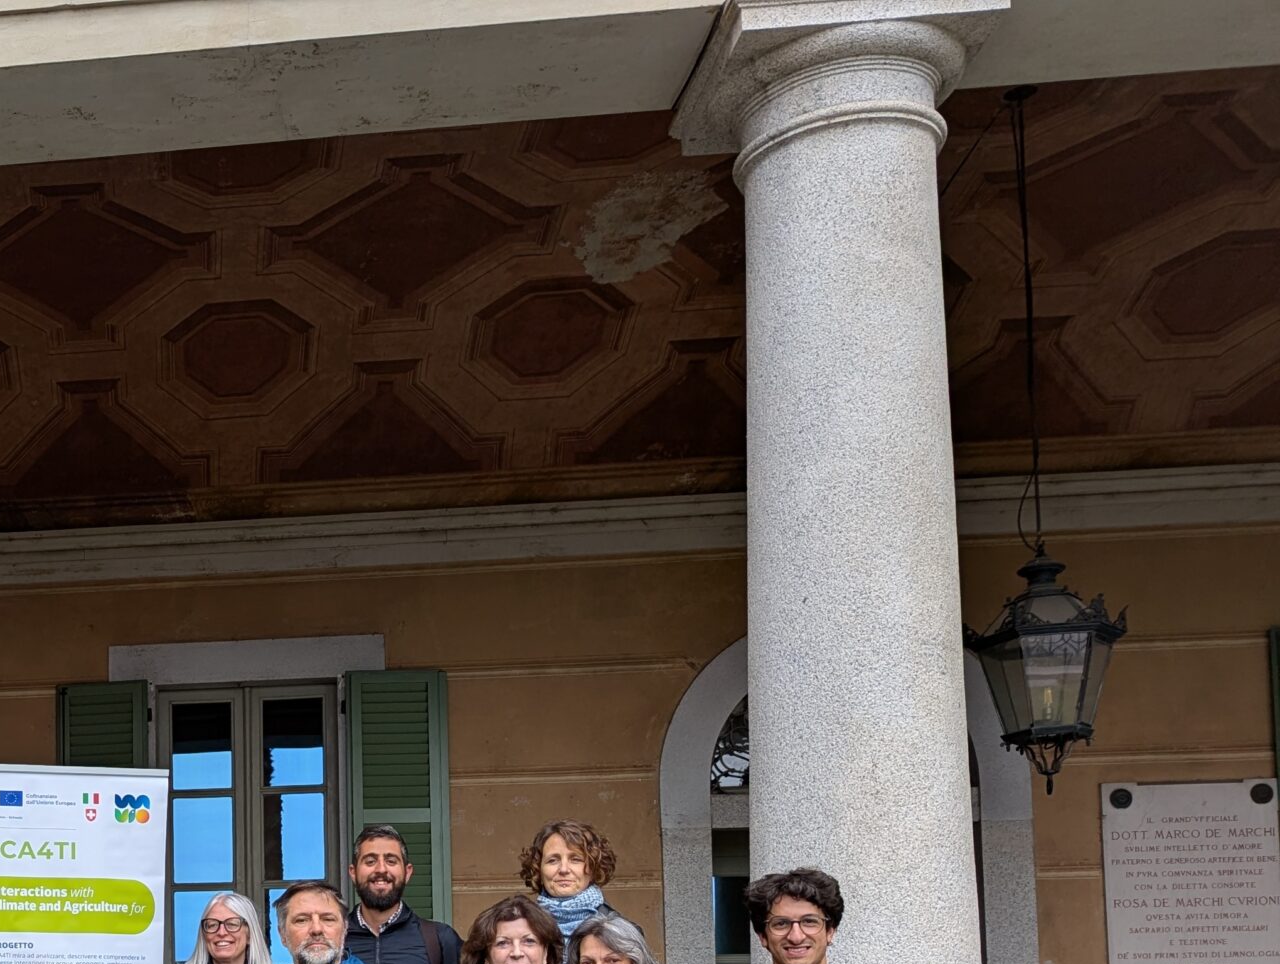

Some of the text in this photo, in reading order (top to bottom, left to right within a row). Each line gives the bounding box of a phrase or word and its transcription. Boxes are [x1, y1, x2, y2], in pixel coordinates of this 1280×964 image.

[1154, 829, 1200, 840] MARCO
[1205, 828, 1223, 838] DE
[1228, 827, 1276, 838] MARCHI
[1111, 858, 1153, 866] FRATERNO
[1163, 857, 1206, 865] GENEROSO
[1161, 870, 1213, 878] COMVNANZA
[1217, 868, 1264, 876] SPIRITVALE
[1134, 883, 1153, 891] CON
[1211, 881, 1257, 889] CONSORTE
[70, 886, 94, 898] with
[39, 900, 61, 912] and
[63, 900, 128, 915] Agriculture
[129, 902, 146, 916] for
[1113, 898, 1148, 909] ROSA
[1153, 898, 1169, 908] DE
[1175, 897, 1223, 908] MARCHI
[1145, 913, 1181, 921] QVESTA
[1213, 912, 1249, 920] DIMORA
[1128, 926, 1171, 934] SACRARIO
[1178, 938, 1228, 946] TESTIMONE
[1132, 952, 1151, 960] SVOI
[1182, 951, 1208, 959] STVDI
